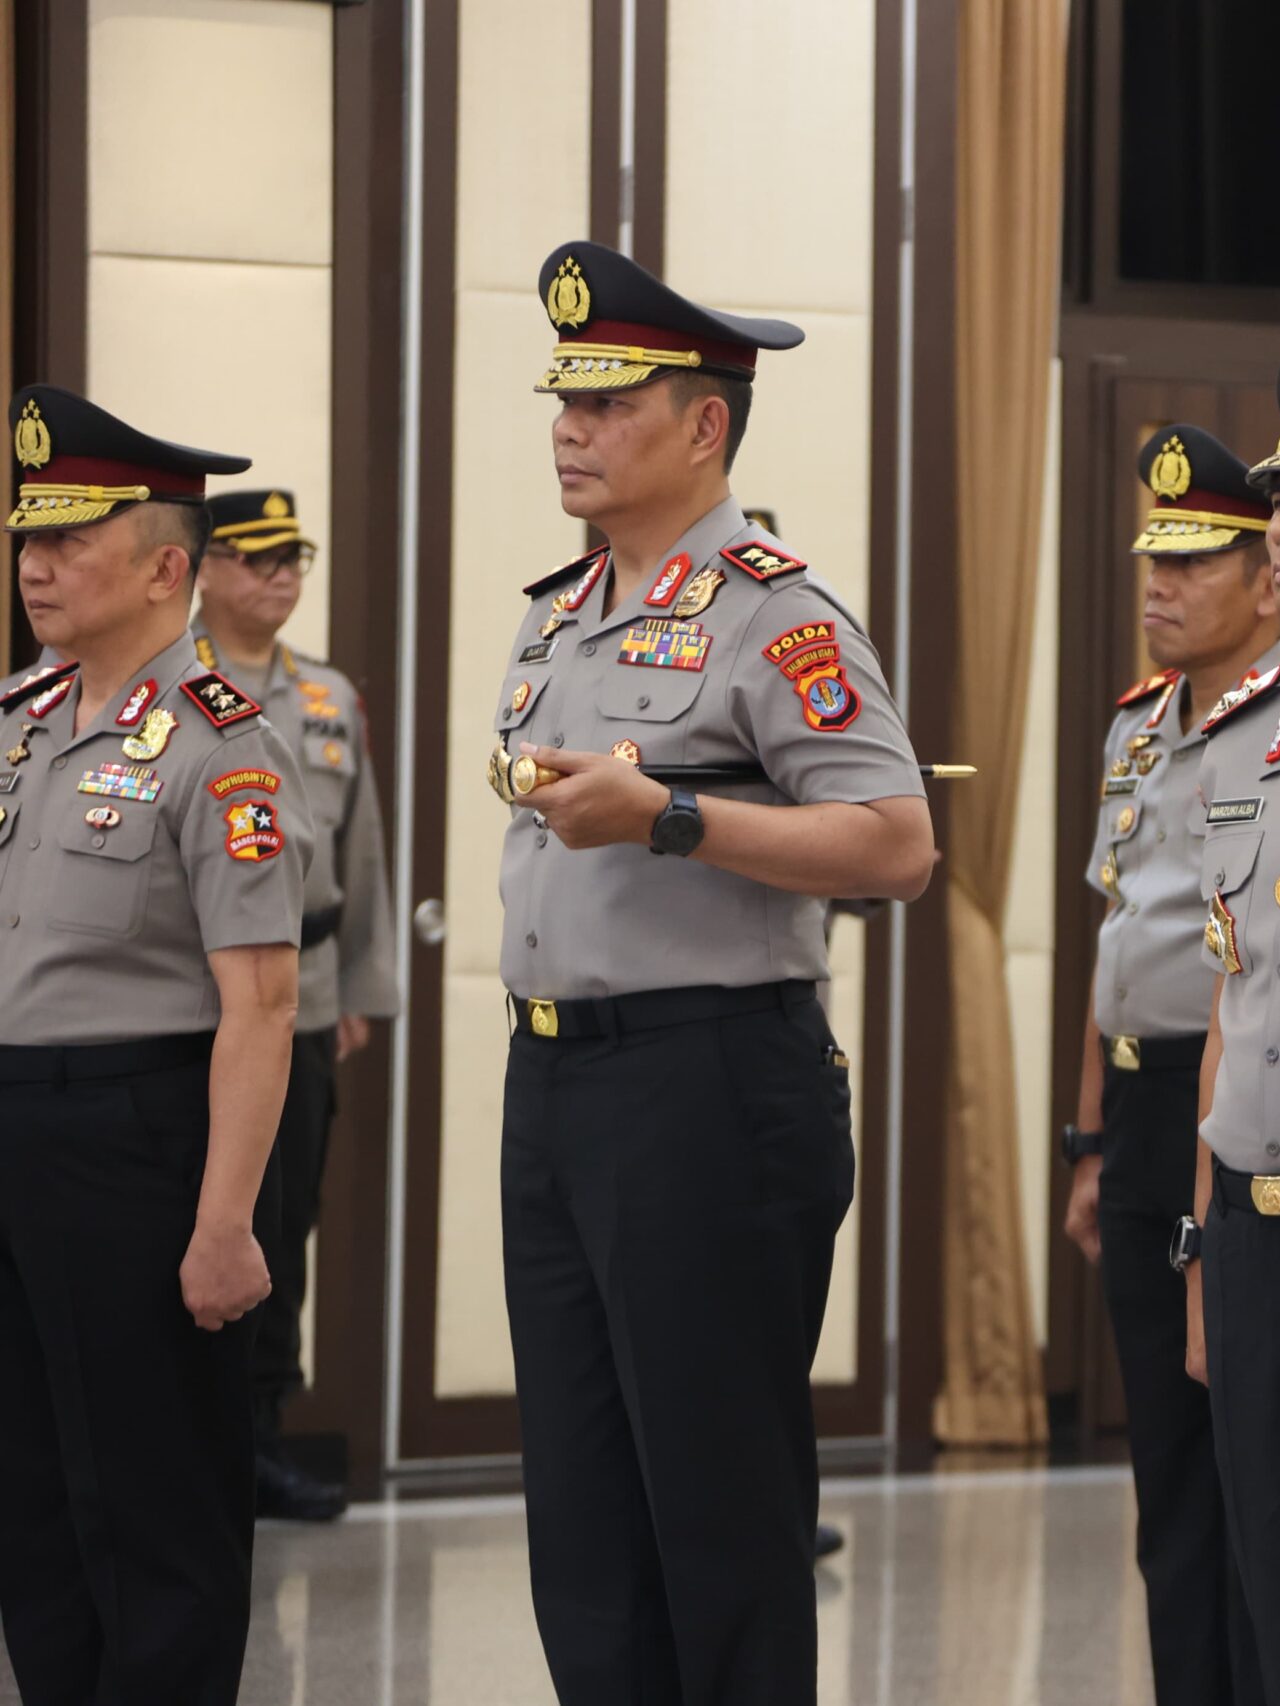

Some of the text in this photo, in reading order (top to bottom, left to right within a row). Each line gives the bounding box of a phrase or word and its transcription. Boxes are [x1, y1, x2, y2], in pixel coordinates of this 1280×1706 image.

[770, 625, 829, 657] POLDA
[787, 647, 835, 674] KALIMANTAN UTARA
[214, 771, 277, 794] DIVHUBINTER
[1209, 803, 1255, 817] MARZUKI ALBA
[230, 834, 279, 851] MABES POLRI
